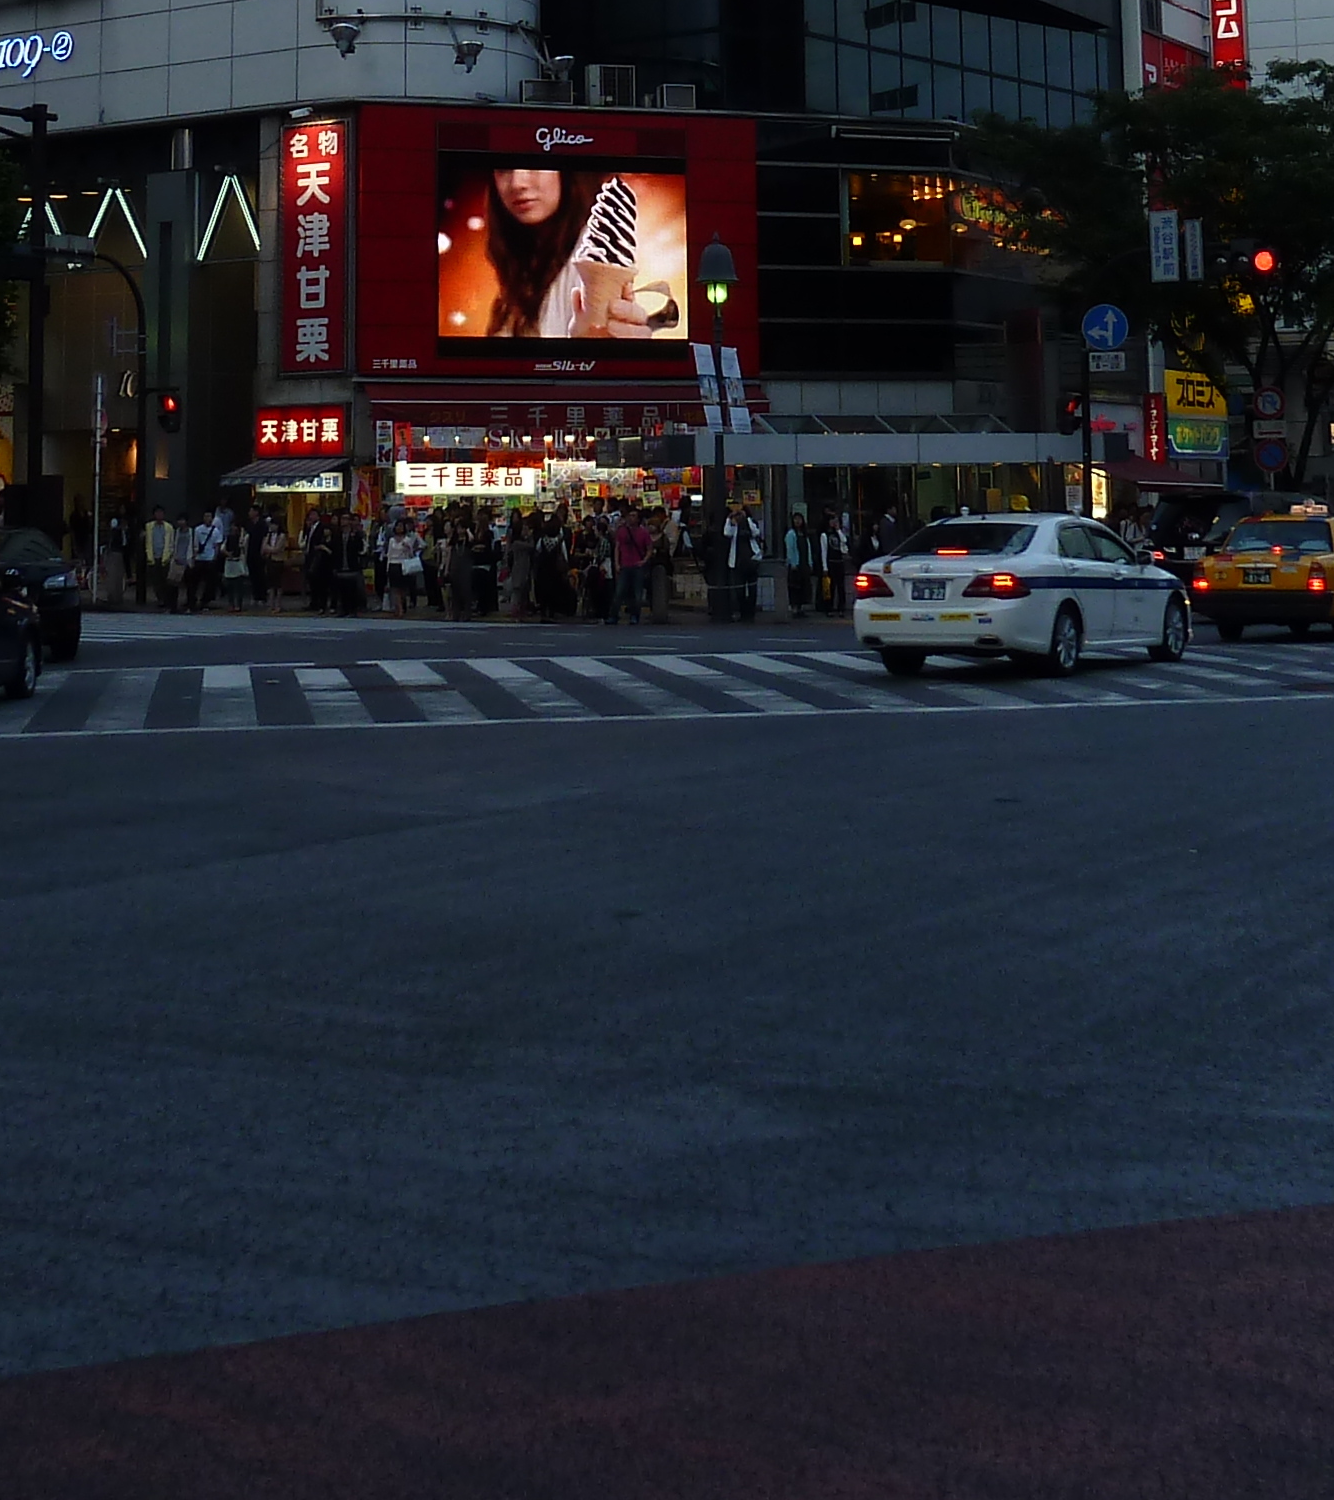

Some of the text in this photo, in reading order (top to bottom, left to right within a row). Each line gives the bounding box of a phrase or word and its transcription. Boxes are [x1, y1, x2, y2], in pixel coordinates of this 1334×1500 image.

[289, 132, 339, 159] 名物
[535, 127, 594, 152] Glico
[296, 161, 331, 363] 天津甘栗
[489, 405, 662, 429] 三千里薬品
[260, 417, 340, 445] 天津甘栗
[408, 465, 523, 488] 三千里薬品
